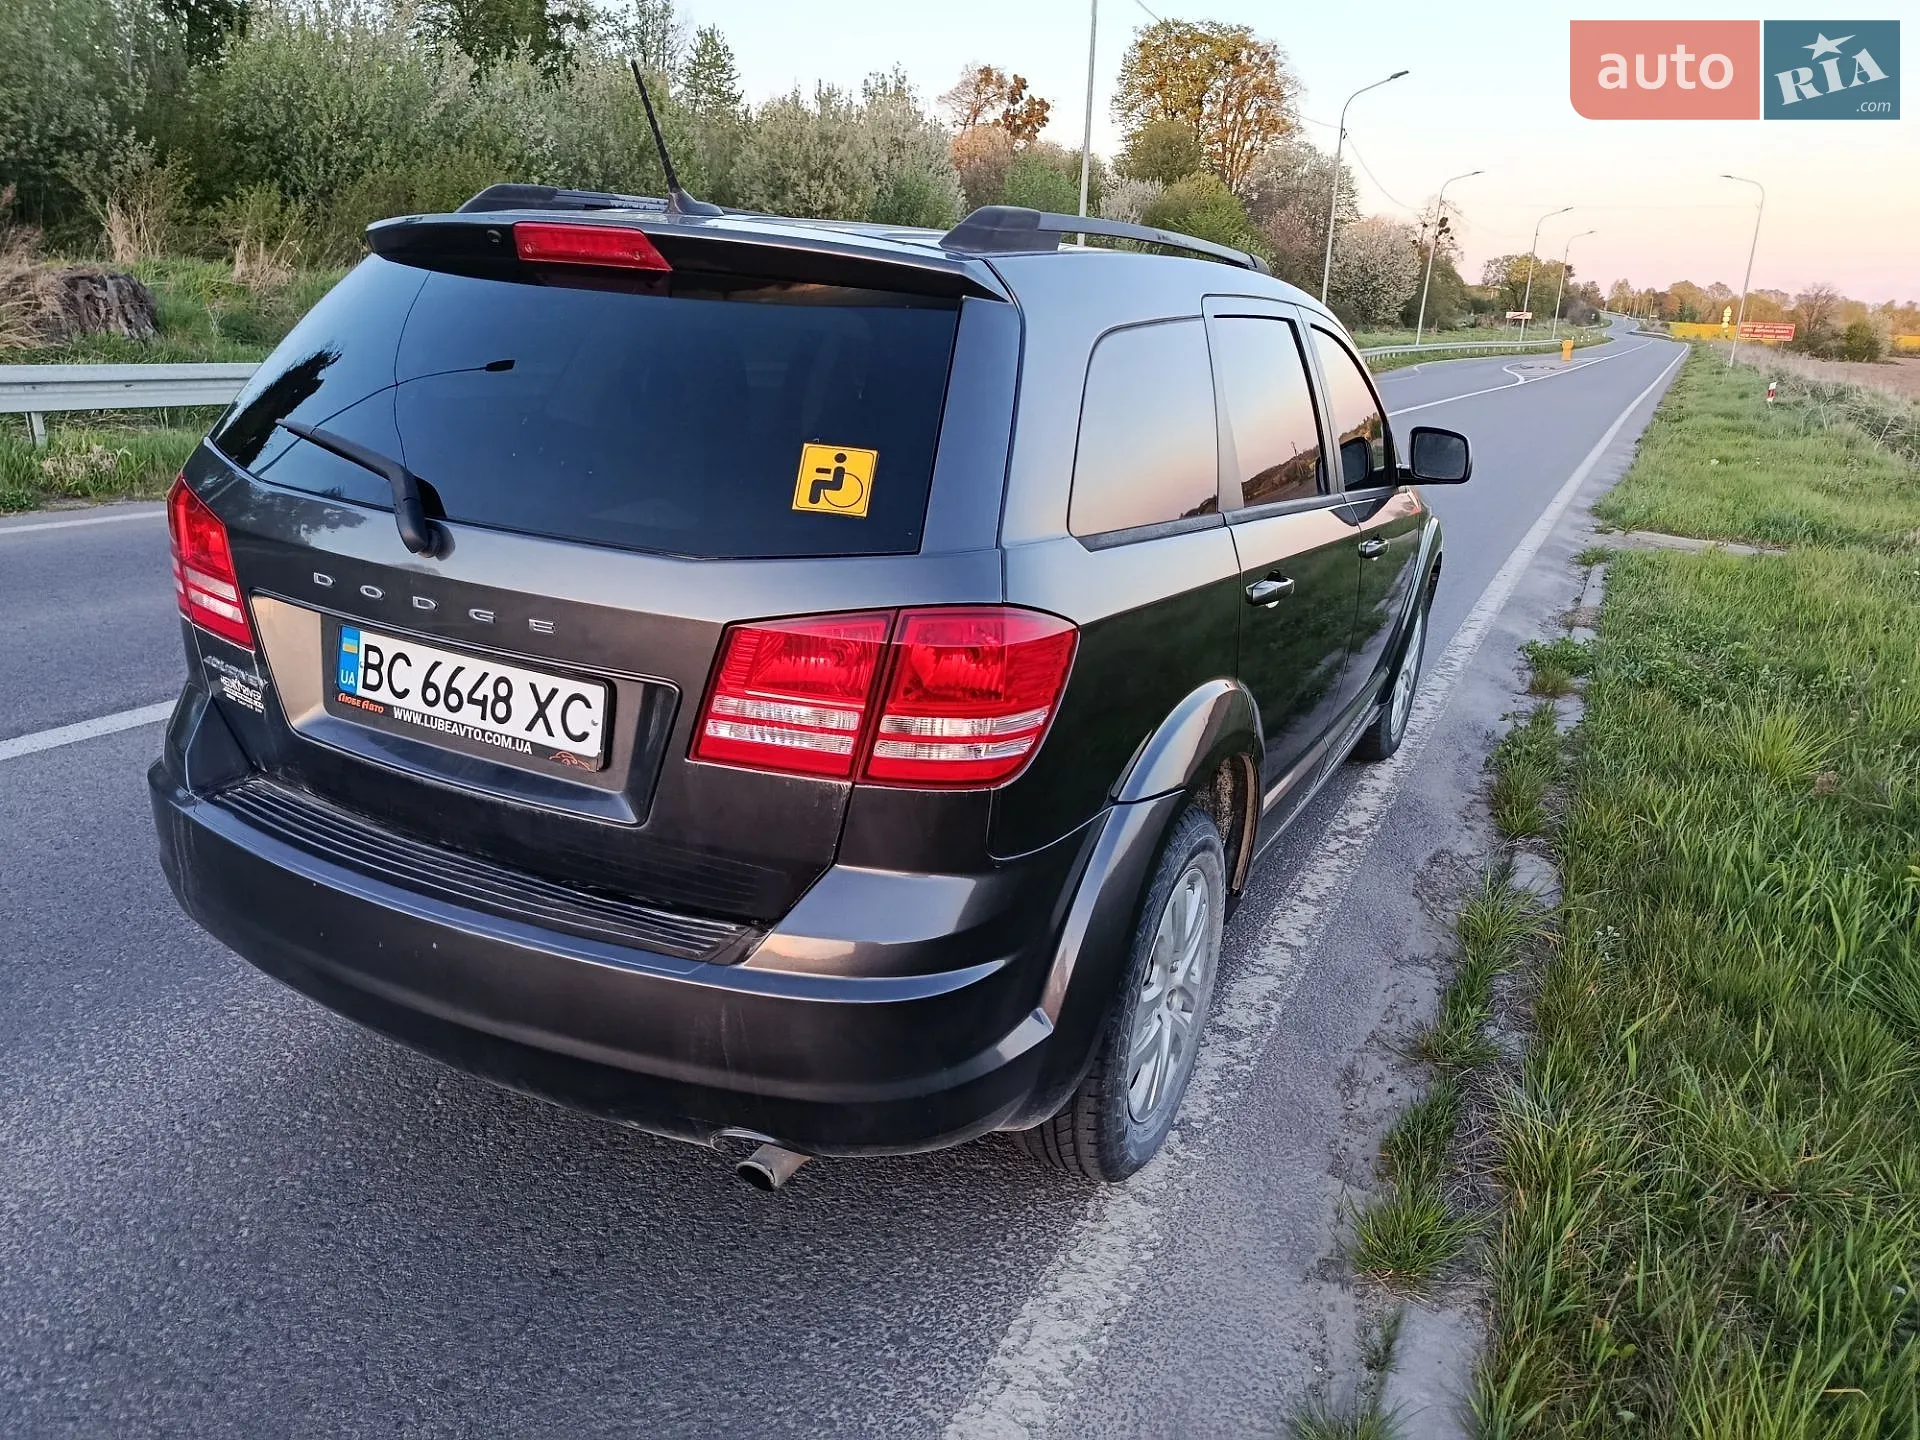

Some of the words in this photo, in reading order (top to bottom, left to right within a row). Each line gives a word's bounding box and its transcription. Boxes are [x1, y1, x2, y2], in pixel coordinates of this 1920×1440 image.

[313, 571, 556, 634] DODGE
[340, 671, 356, 687] UA
[361, 643, 412, 700] BC
[421, 660, 514, 725] 6648
[524, 682, 593, 743] XC
[393, 706, 533, 755] WWW.LUBEAVTO.COM.UA
